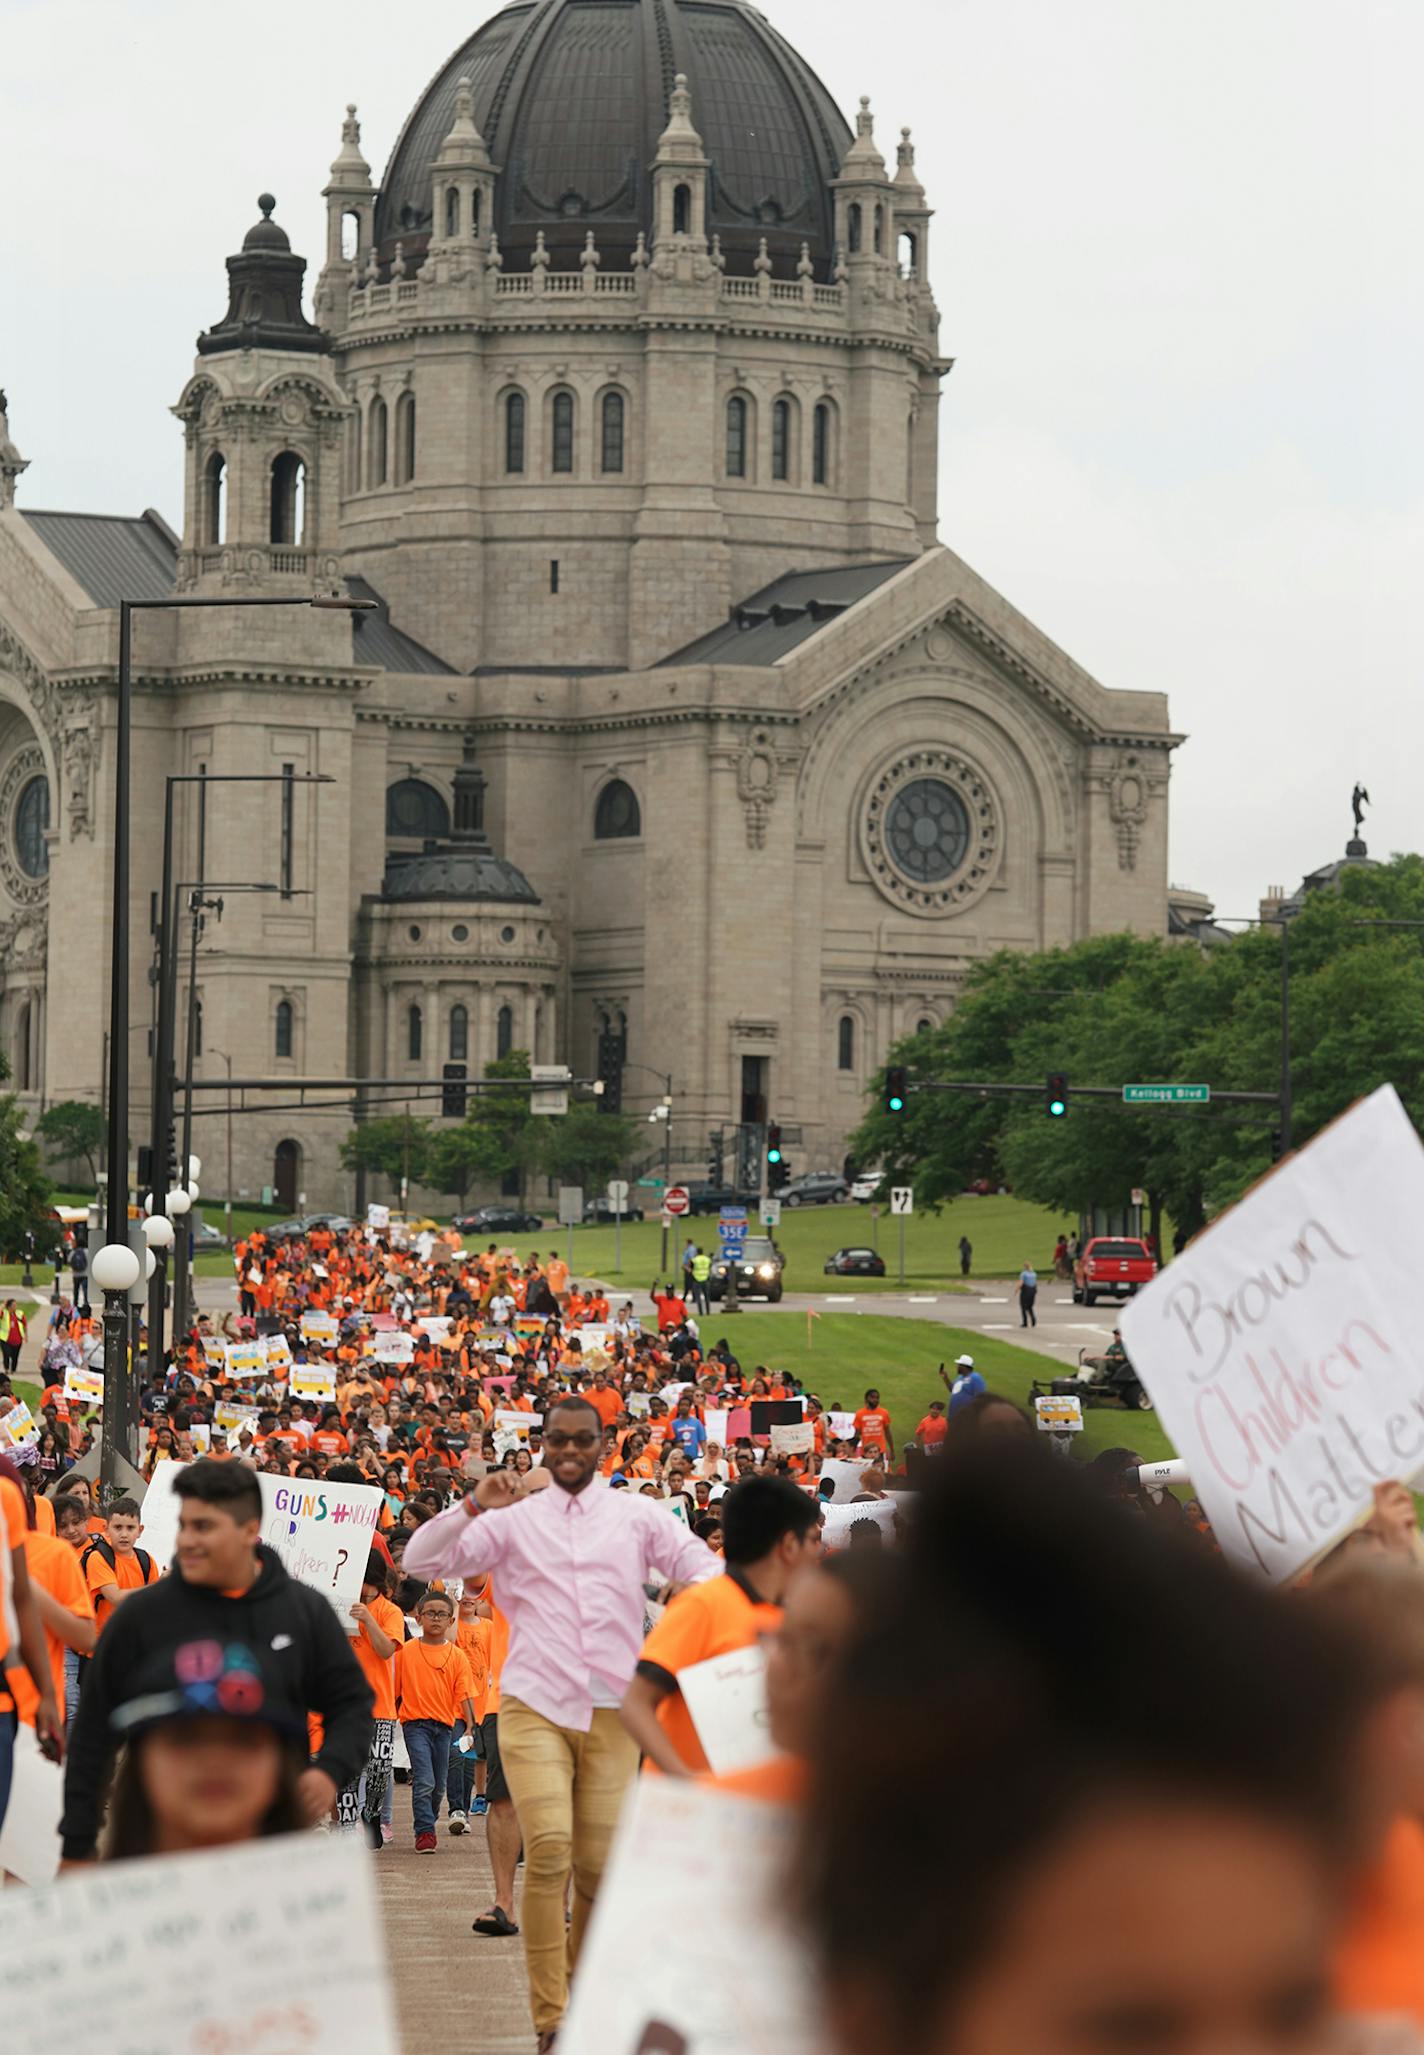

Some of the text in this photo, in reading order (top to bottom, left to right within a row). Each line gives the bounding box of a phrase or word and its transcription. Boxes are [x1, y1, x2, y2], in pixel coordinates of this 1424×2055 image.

[1130, 1088, 1202, 1101] Kellogg Blvd
[722, 1226, 744, 1240] 35E
[1163, 1219, 1362, 1384] Brown
[1194, 1318, 1392, 1492] Children
[275, 1489, 328, 1522] GUNS
